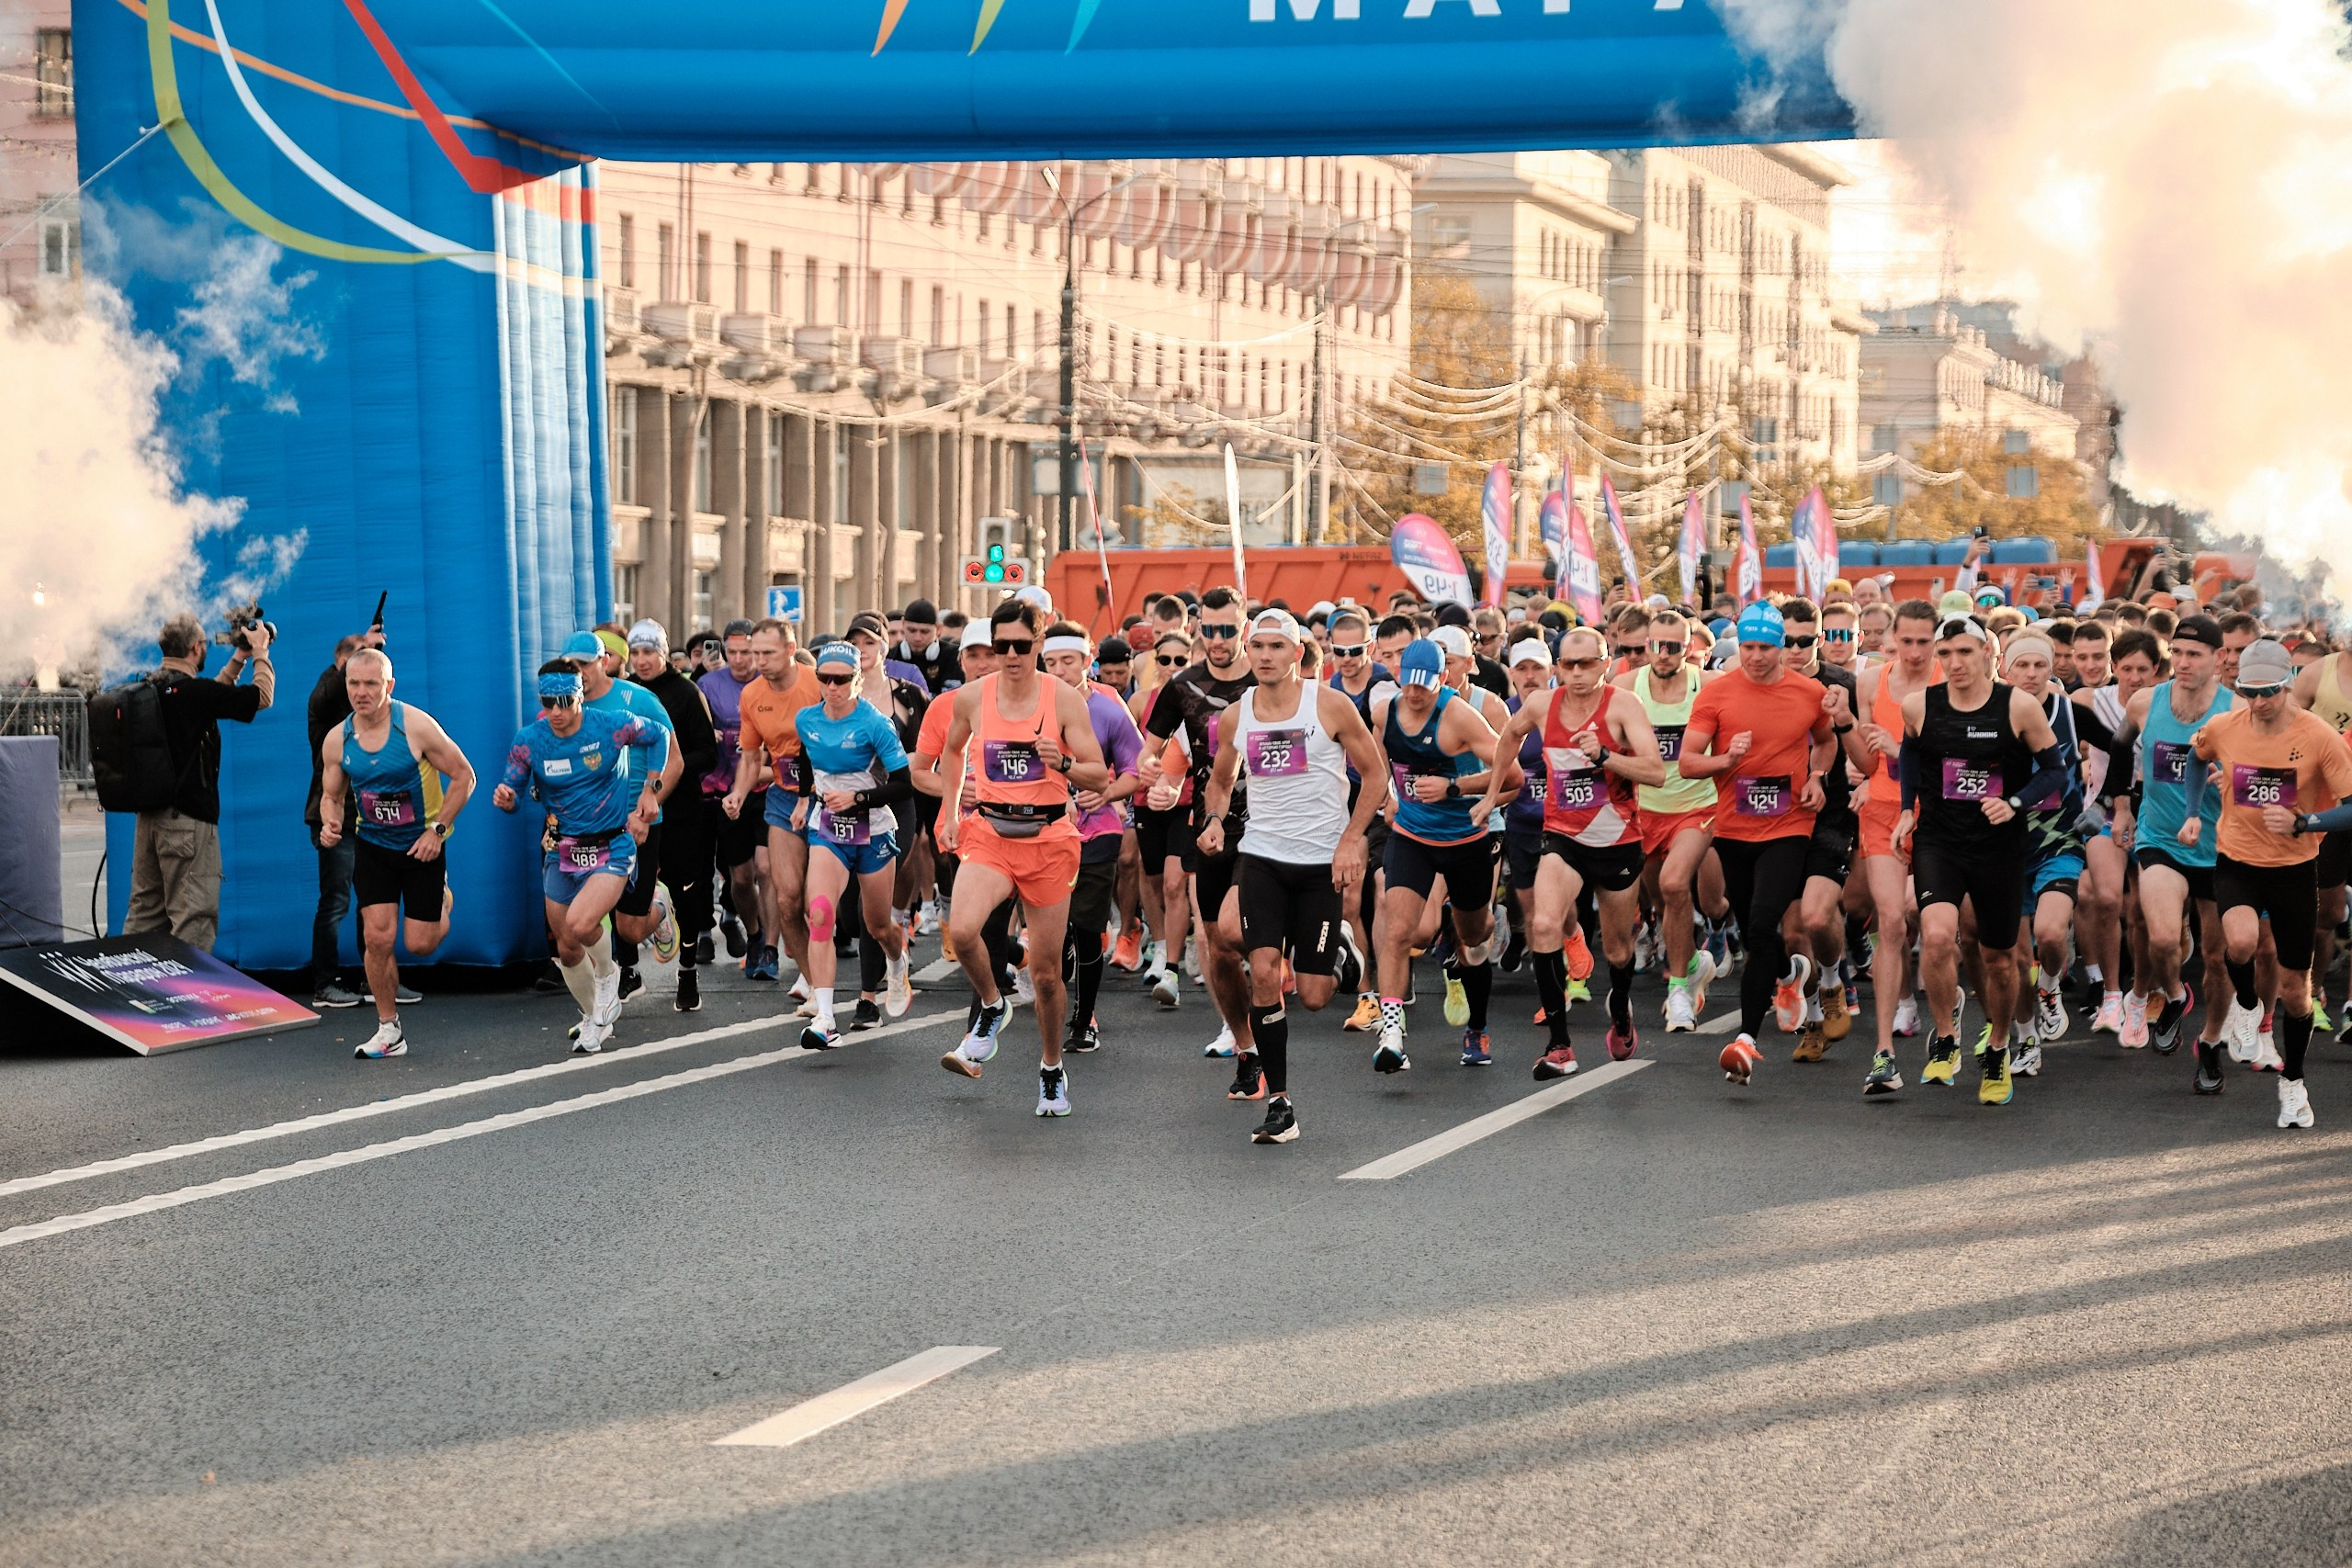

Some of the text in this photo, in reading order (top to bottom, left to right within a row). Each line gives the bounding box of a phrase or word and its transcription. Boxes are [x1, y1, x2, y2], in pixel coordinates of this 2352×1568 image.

[1001, 759, 1028, 775] 146
[1261, 750, 1291, 768] 232
[1565, 785, 1594, 804] 503
[1957, 777, 1987, 795] 252
[2248, 784, 2280, 802] 286
[1748, 794, 1778, 809] 424
[375, 807, 401, 821] 674
[833, 822, 854, 839] 137
[571, 852, 597, 866] 488
[153, 959, 194, 976] 2024
